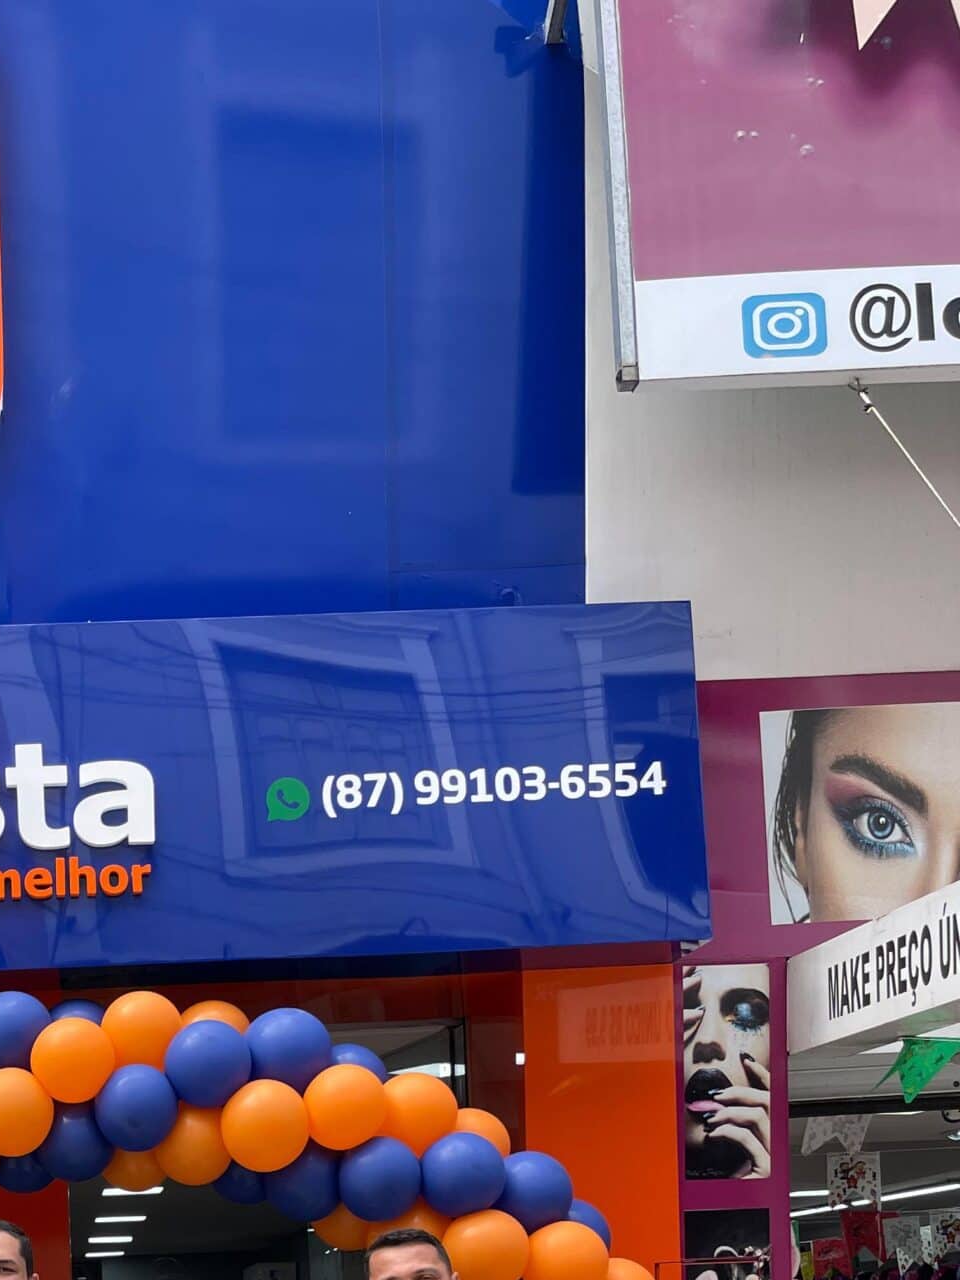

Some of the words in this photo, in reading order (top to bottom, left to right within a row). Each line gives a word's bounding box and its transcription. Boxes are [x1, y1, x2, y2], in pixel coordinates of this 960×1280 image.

[322, 771, 405, 818] (87)
[414, 760, 667, 806] 99103-6554
[828, 950, 871, 1021] MAKE
[875, 924, 932, 1007] PREÇO
